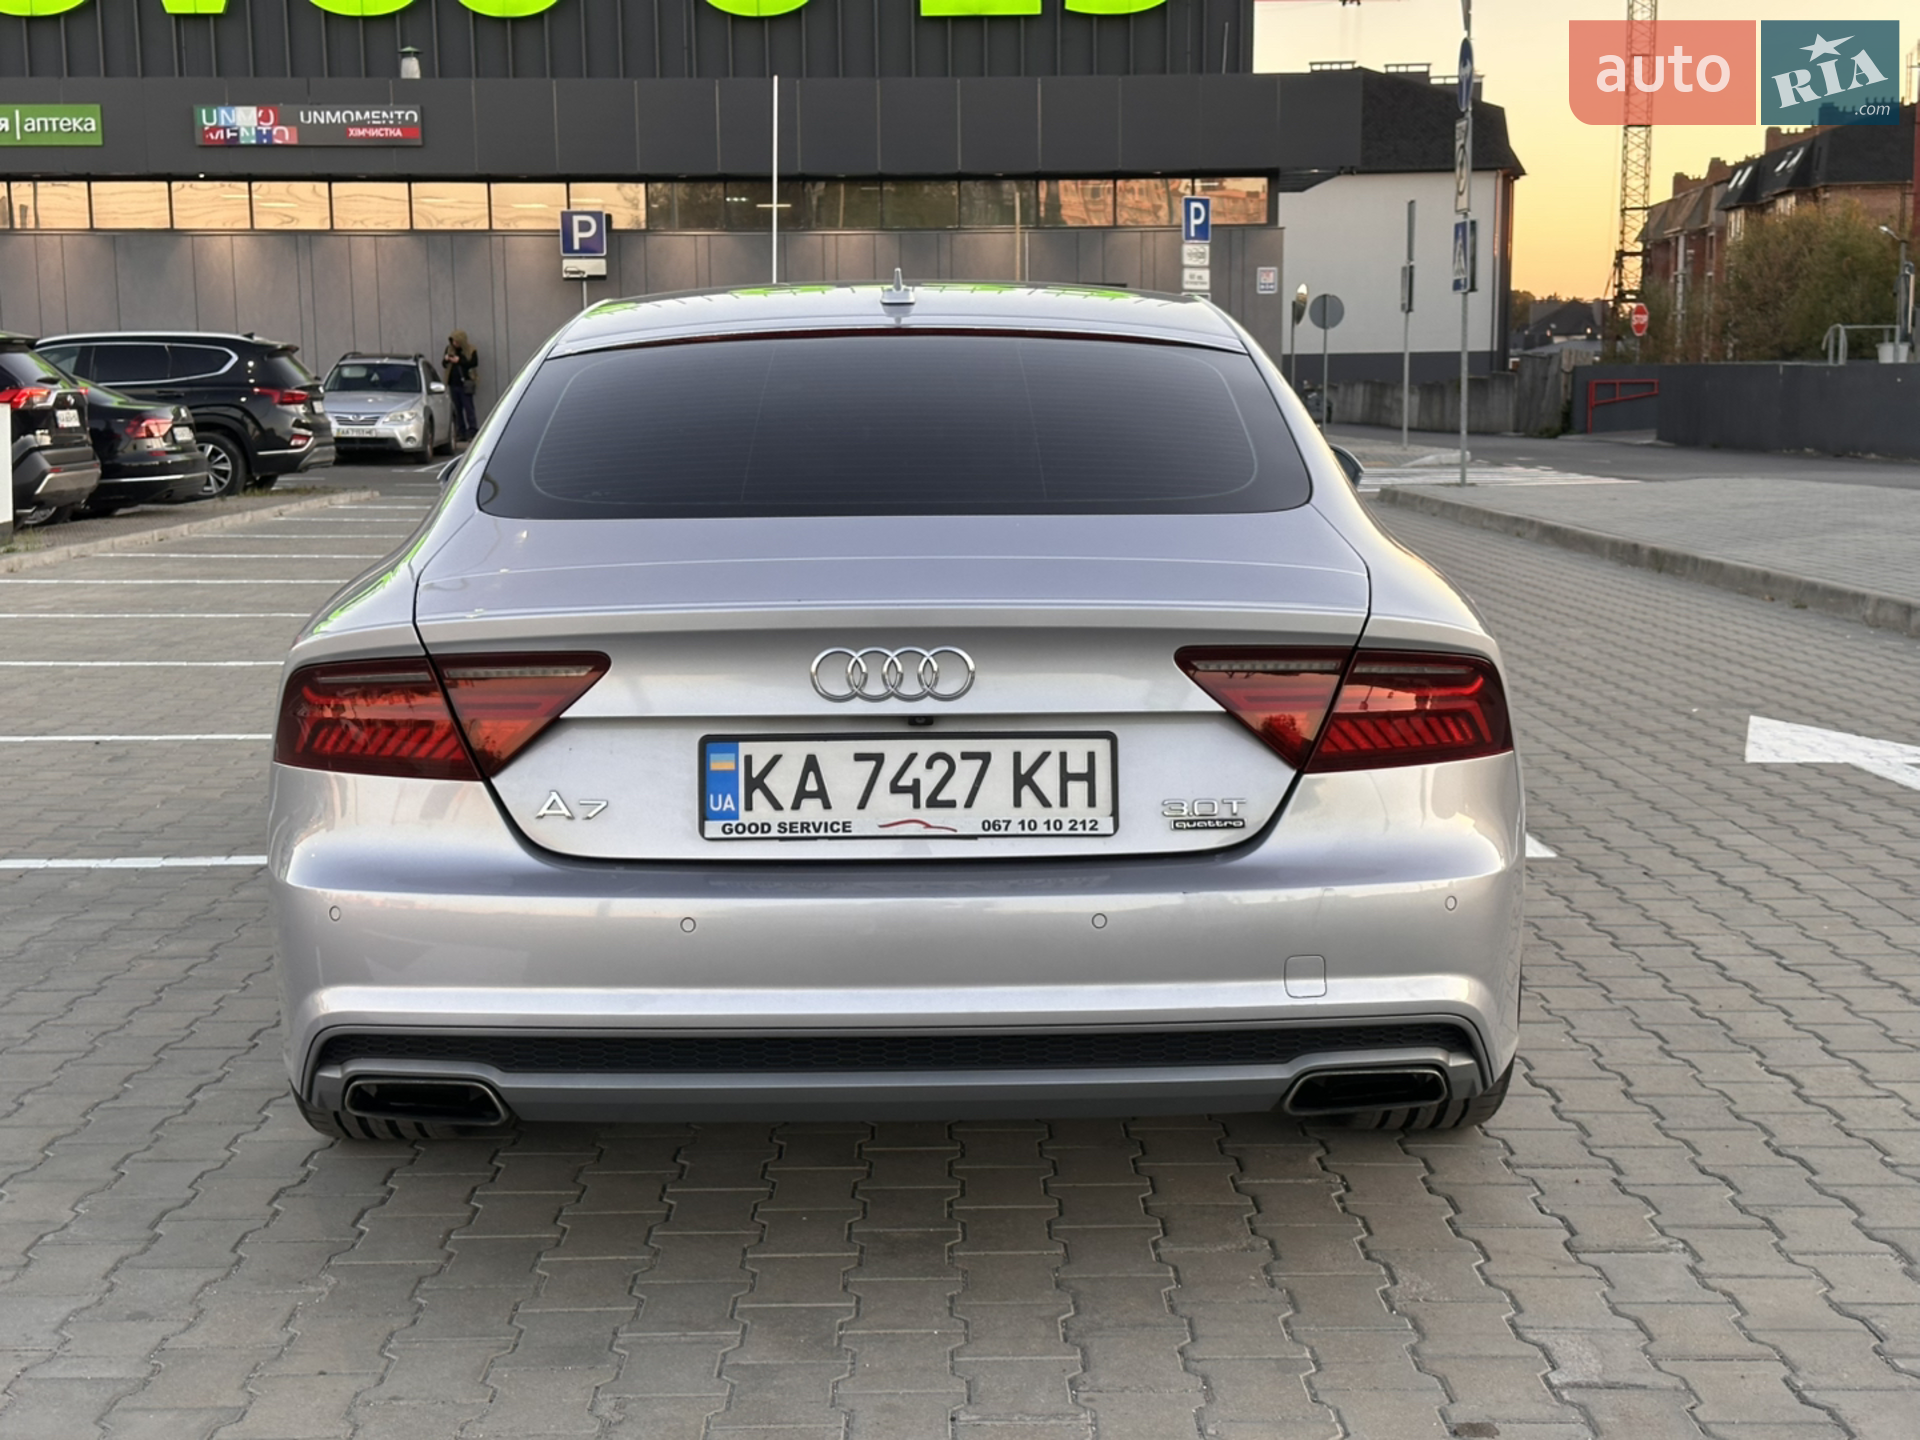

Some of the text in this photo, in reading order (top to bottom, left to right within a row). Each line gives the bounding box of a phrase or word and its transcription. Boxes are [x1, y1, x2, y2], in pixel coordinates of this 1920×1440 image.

[24, 116, 97, 132] аптека
[299, 109, 418, 125] UNMOMENTO
[348, 128, 403, 138] ХІМЧИСТКА
[1189, 201, 1206, 237] P
[572, 214, 597, 250] P
[709, 751, 1097, 812] UA KA 7427 KH
[535, 789, 609, 820] A7
[1161, 797, 1247, 817] 3.0T
[721, 821, 853, 835] GOOD SERVICE
[981, 819, 1099, 832] 067 10 10 212
[1174, 820, 1244, 829] quattro
